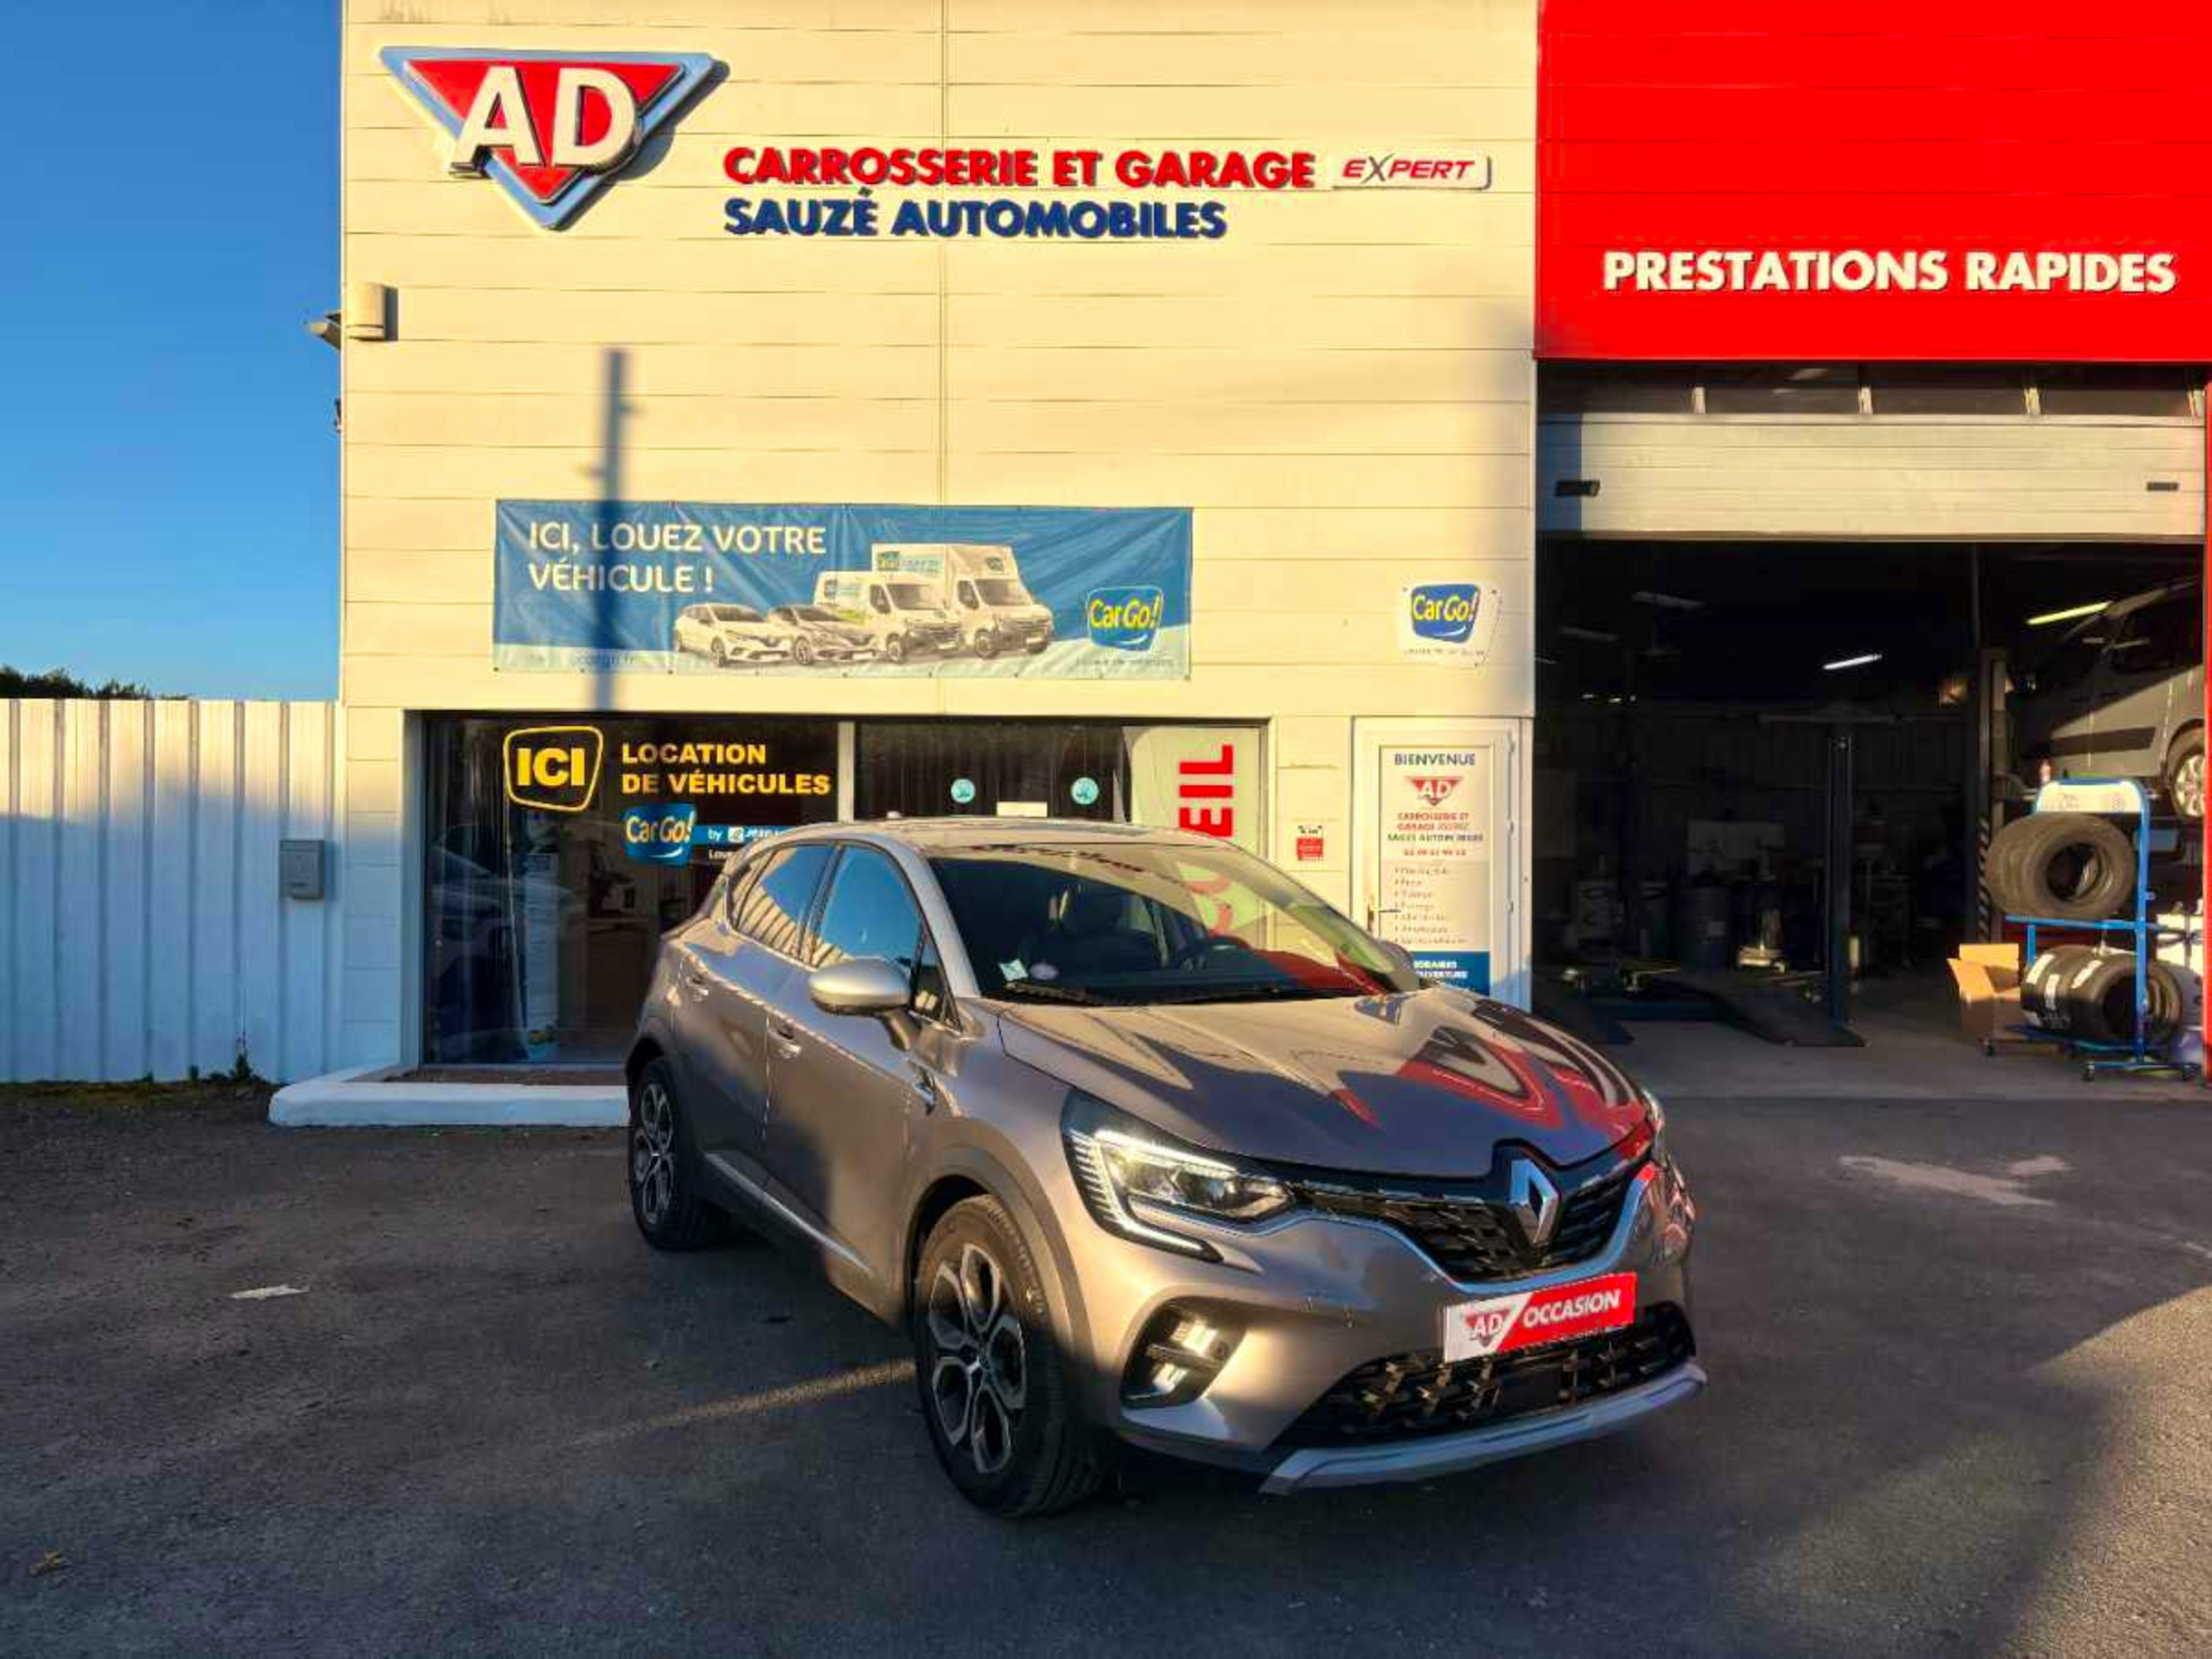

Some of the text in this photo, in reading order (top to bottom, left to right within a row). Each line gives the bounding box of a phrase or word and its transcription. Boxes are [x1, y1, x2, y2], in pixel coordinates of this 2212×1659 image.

[449, 65, 637, 174] AD
[723, 147, 1316, 188] CARROSSERIE ET GARAGE
[890, 199, 1227, 237] AUTOMOBILES
[1604, 250, 2176, 294] PRESTATIONS RAPIDES
[529, 521, 827, 555] ICI, LOUEZ VOTRE
[528, 558, 694, 592] VÉHICULE
[517, 748, 585, 786] ICI
[622, 744, 767, 764] LOCATION
[1395, 753, 1475, 766] BIENVENUE
[622, 769, 831, 794] DE VÉHICULES
[1418, 779, 1453, 798] AD
[708, 828, 723, 841] by
[1472, 1289, 1621, 1338] AD OCCASION
